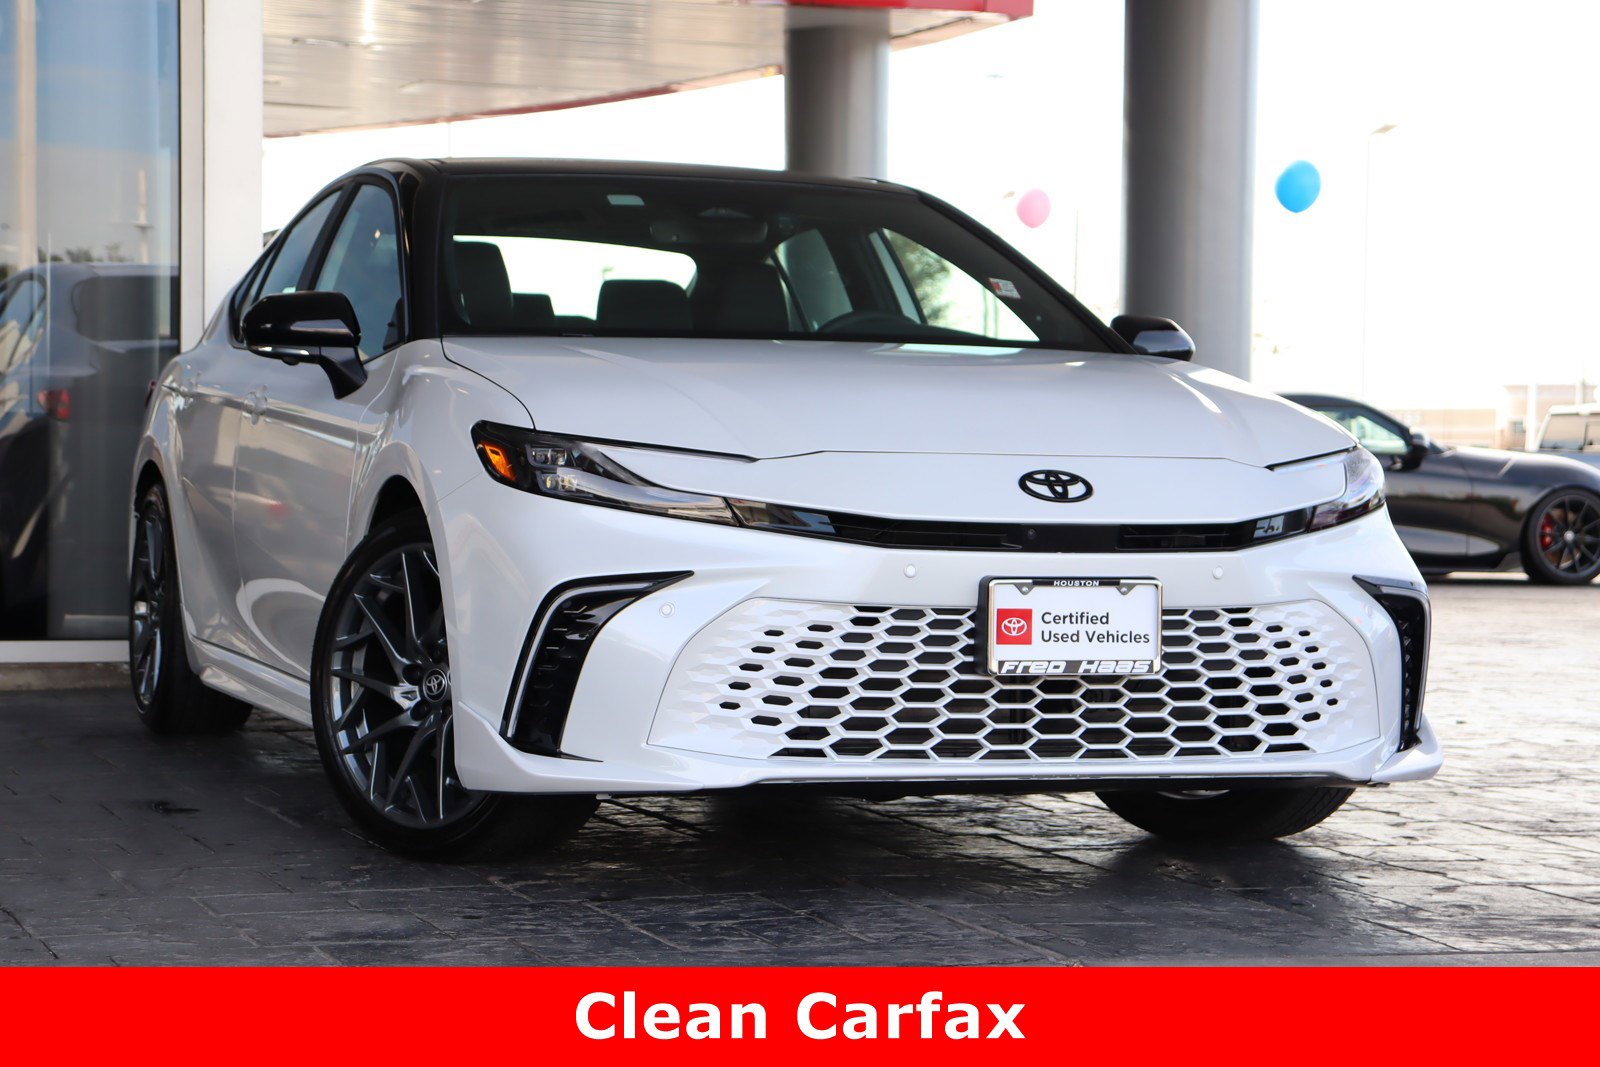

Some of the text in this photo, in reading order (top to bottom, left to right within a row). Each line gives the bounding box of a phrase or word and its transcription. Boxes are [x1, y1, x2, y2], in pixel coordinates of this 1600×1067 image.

[1041, 612, 1109, 625] Certified
[1041, 630, 1150, 643] Used Vehicles
[1078, 660, 1152, 674] Haas
